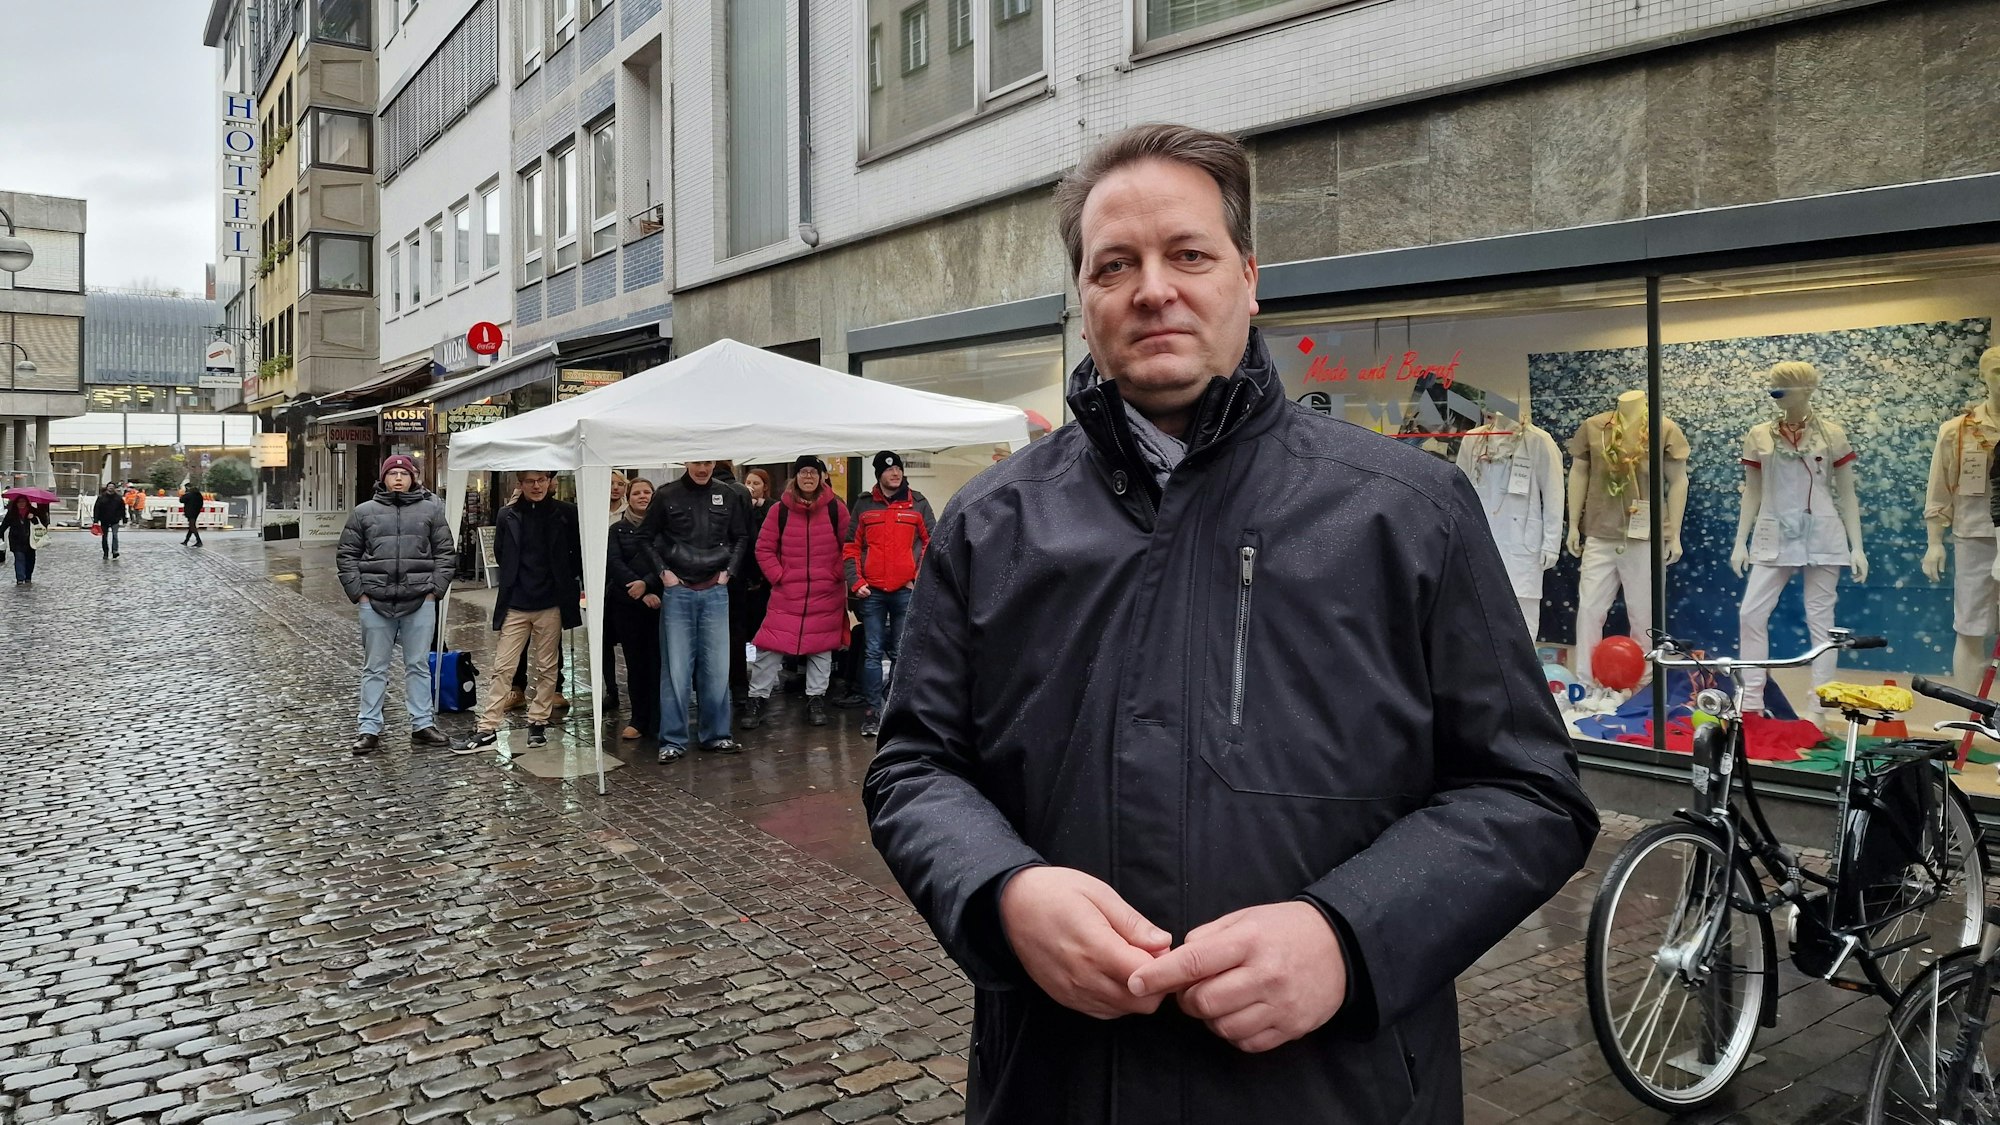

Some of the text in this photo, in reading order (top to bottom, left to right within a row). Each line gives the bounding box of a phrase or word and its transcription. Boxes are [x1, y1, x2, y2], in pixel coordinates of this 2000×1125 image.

[226, 95, 255, 254] HOTEL
[443, 337, 468, 366] KIOSK
[98, 367, 180, 384] MUSEUM
[1303, 353, 1349, 385] Mode
[383, 409, 426, 420] KIOSK
[330, 427, 372, 442] SOUVENIRS
